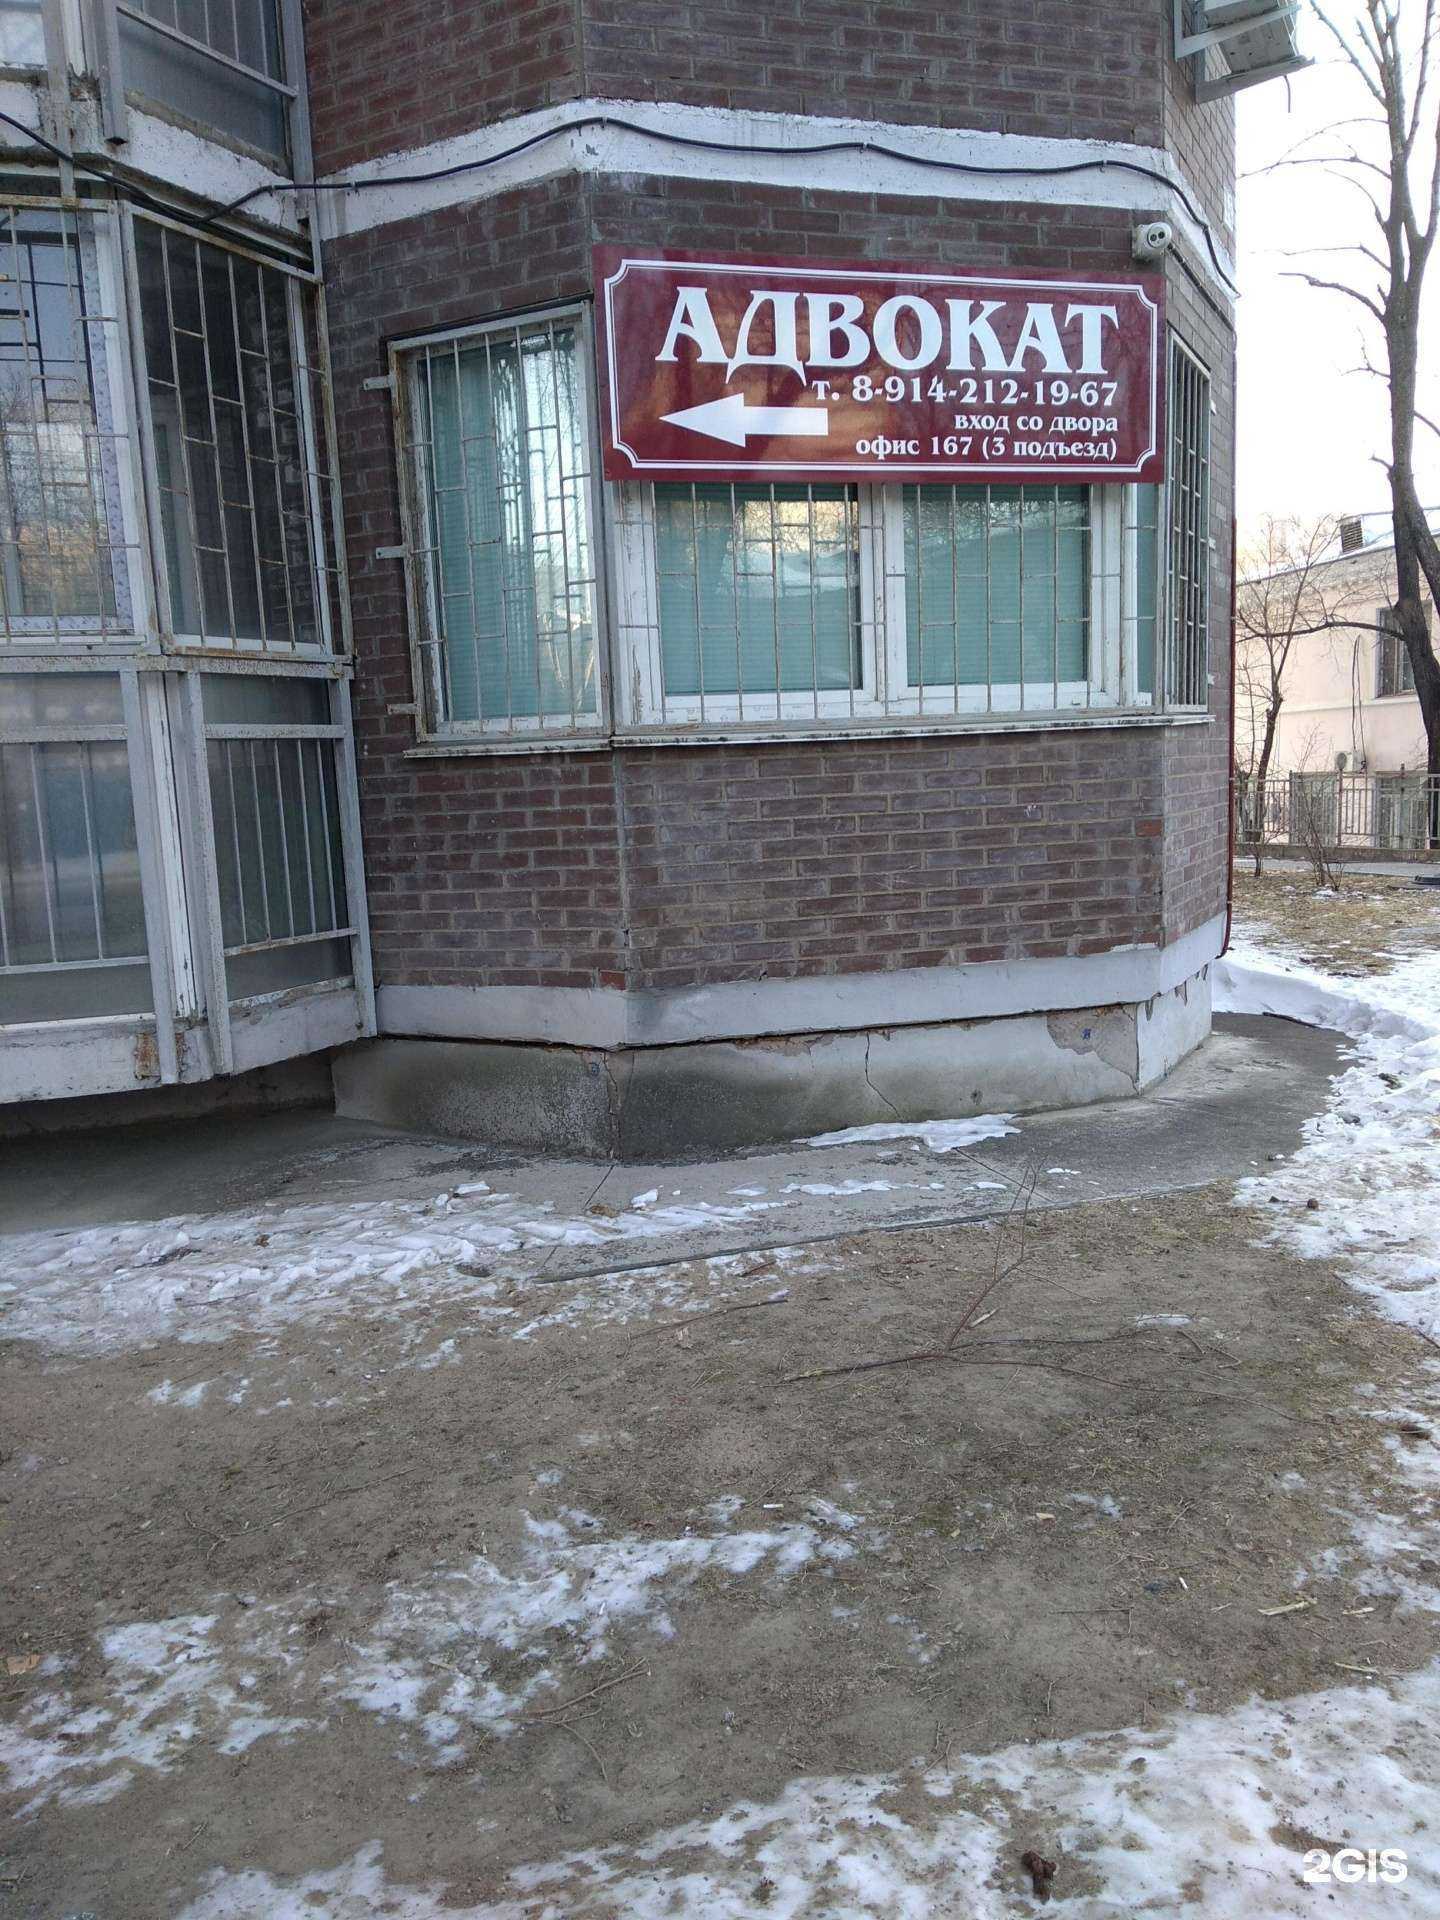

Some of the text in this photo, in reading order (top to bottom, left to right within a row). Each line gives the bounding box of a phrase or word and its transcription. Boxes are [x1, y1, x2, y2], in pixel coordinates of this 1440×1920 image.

[655, 286, 1118, 386] АДВОКАТ
[812, 374, 1118, 407] т. 8-914-212-19-67
[954, 413, 1118, 435] вход со двора
[855, 436, 1118, 461] офис 167 (3 подъезд)
